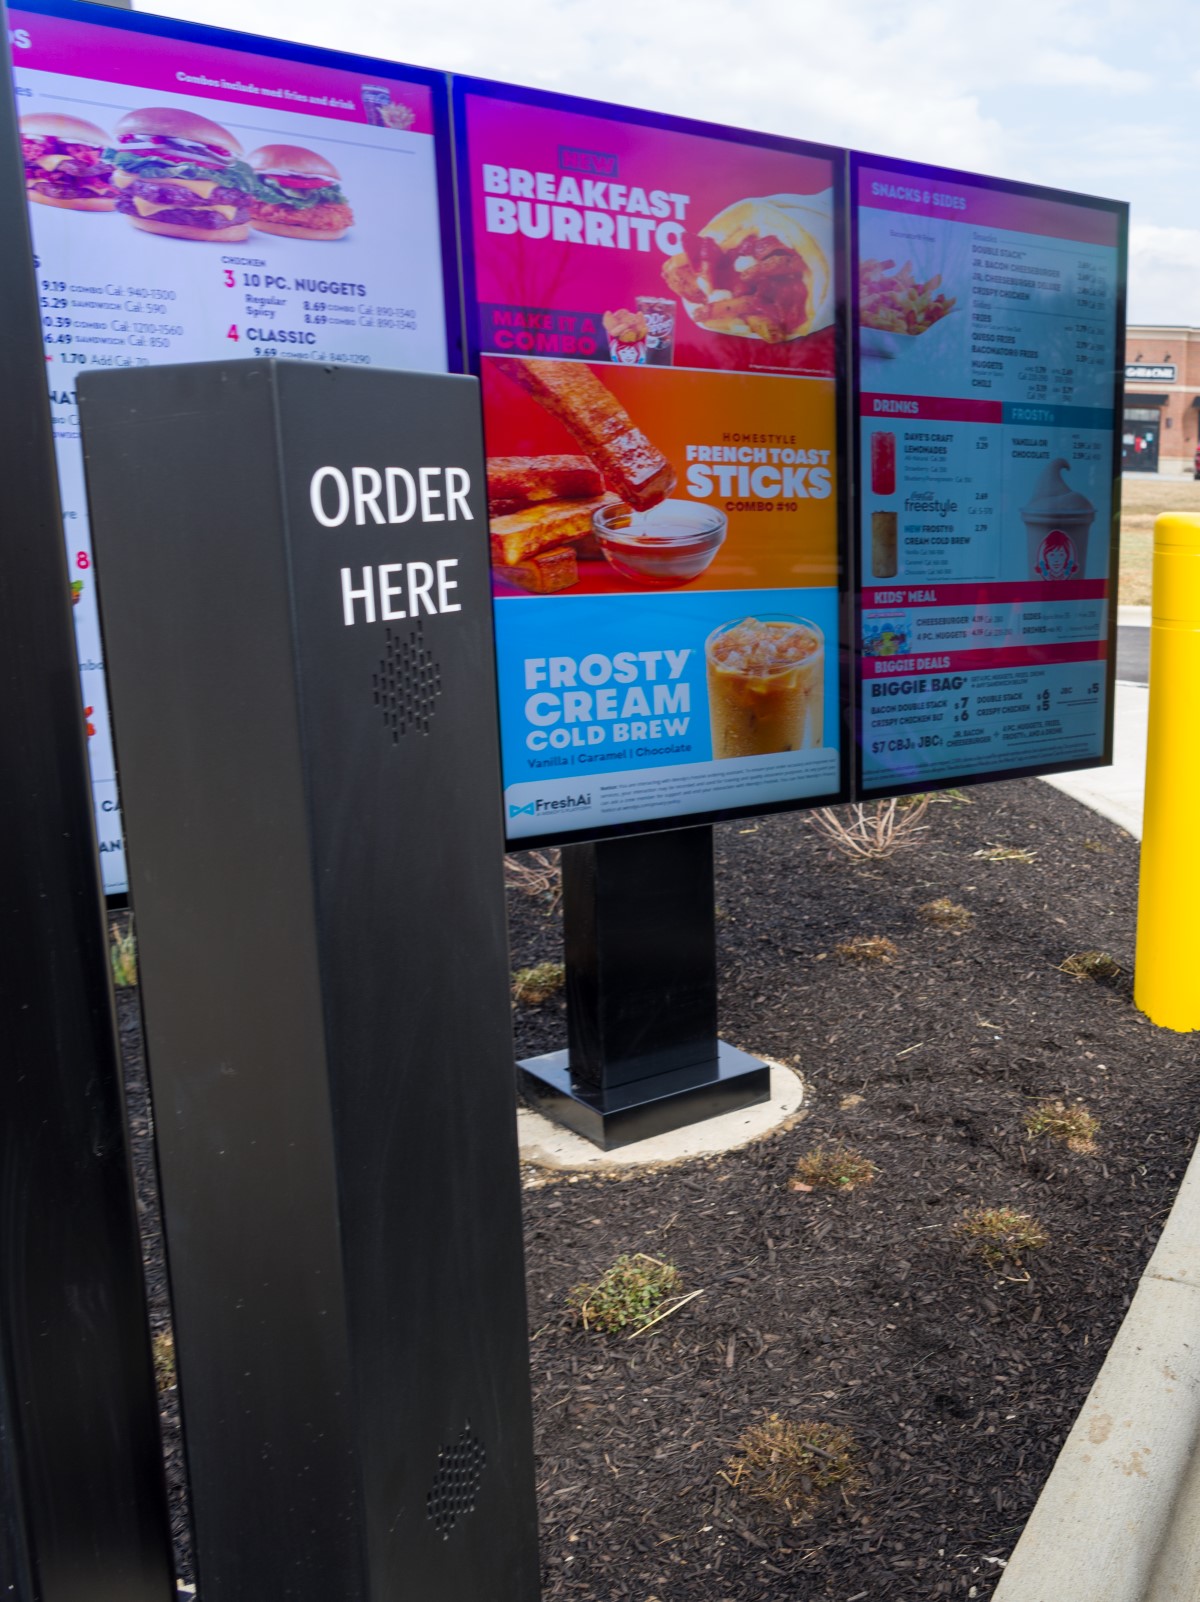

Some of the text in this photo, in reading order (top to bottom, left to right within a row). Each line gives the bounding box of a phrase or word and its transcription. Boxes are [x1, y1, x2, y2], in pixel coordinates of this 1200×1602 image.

[176, 71, 219, 87] Combos
[221, 79, 259, 94] include
[309, 96, 327, 107] and
[330, 97, 355, 110] drink
[562, 150, 615, 174] NEW
[483, 163, 690, 220] BREAKFAST
[871, 181, 921, 204] SNACKS
[933, 192, 966, 210] SIDES
[484, 196, 687, 257] BURRITO
[221, 256, 266, 267] CHICKEN
[224, 270, 366, 297] 3 10 PC. NUGGETS
[245, 294, 287, 307] Regular
[42, 316, 72, 328] 0.39
[493, 309, 597, 333] MAKE IT A
[226, 324, 316, 345] 4 CLASSIC
[493, 330, 597, 355] COMBO
[873, 399, 919, 414] DRINKS
[723, 433, 796, 445] HOMESTYLE
[686, 445, 830, 465] FRENCH TOAST
[686, 463, 832, 499] STICKS
[310, 466, 474, 527] ORDER
[725, 502, 798, 512] COMBO #10
[904, 498, 958, 517] freestyle
[76, 551, 90, 569] 8
[340, 558, 462, 626] HERE
[874, 590, 937, 604] KIDS' MEAL
[524, 648, 693, 690] FROSTY
[874, 656, 950, 673] BIGGIE DEALS
[872, 679, 927, 697] BIGGIE
[524, 683, 691, 726] CREAM
[872, 704, 897, 714] BACON
[898, 702, 925, 712] DOUBLE
[926, 700, 948, 709] STACK
[526, 717, 691, 751] COLD BREW
[528, 743, 692, 768] Vanilla Caramel Chocolate
[536, 793, 591, 811] FreshAi
